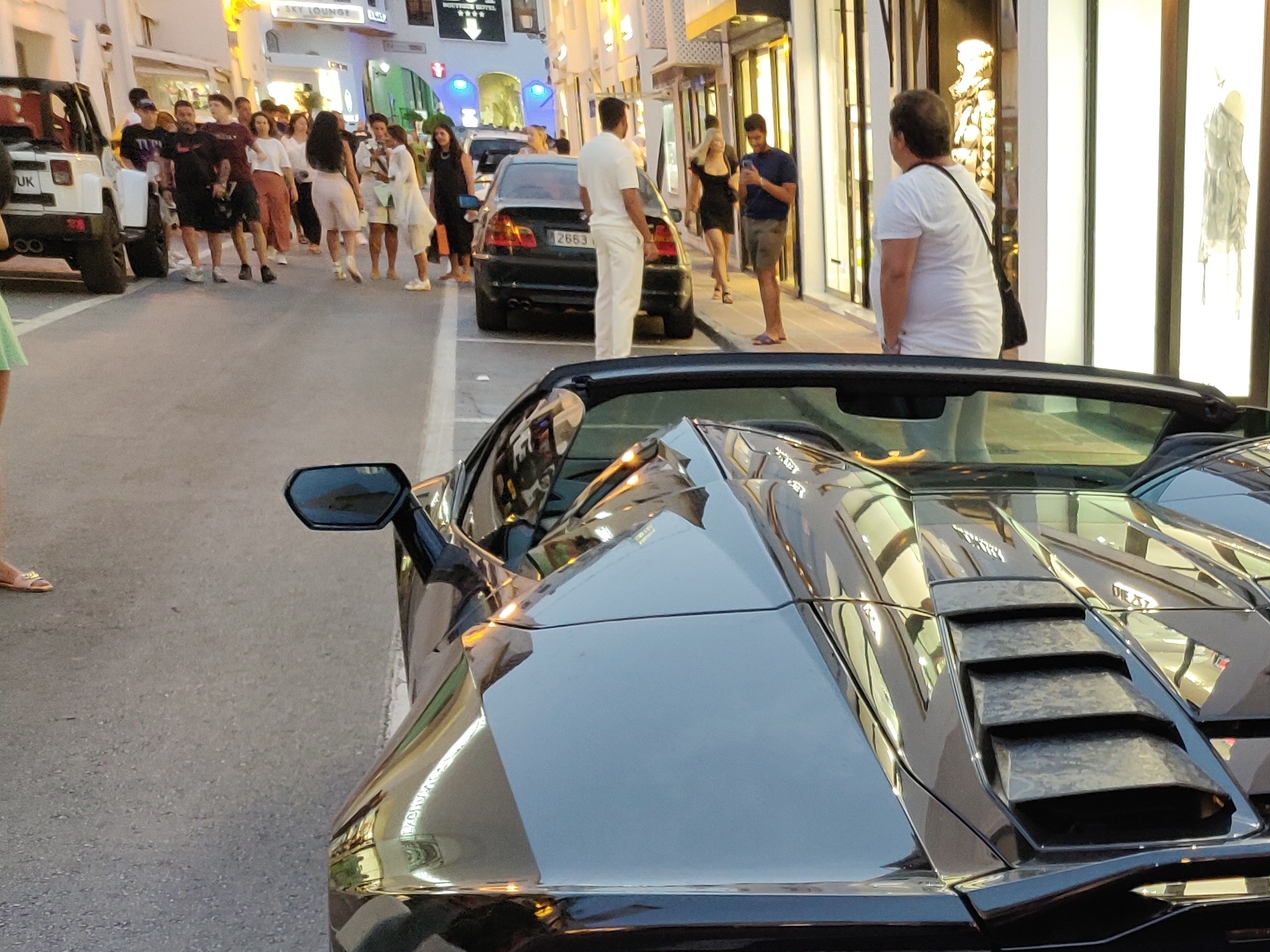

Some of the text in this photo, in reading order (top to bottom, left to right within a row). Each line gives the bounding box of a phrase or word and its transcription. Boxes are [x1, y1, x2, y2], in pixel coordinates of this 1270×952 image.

[284, 5, 351, 16] SKY LOUNGE
[17, 176, 35, 188] UK
